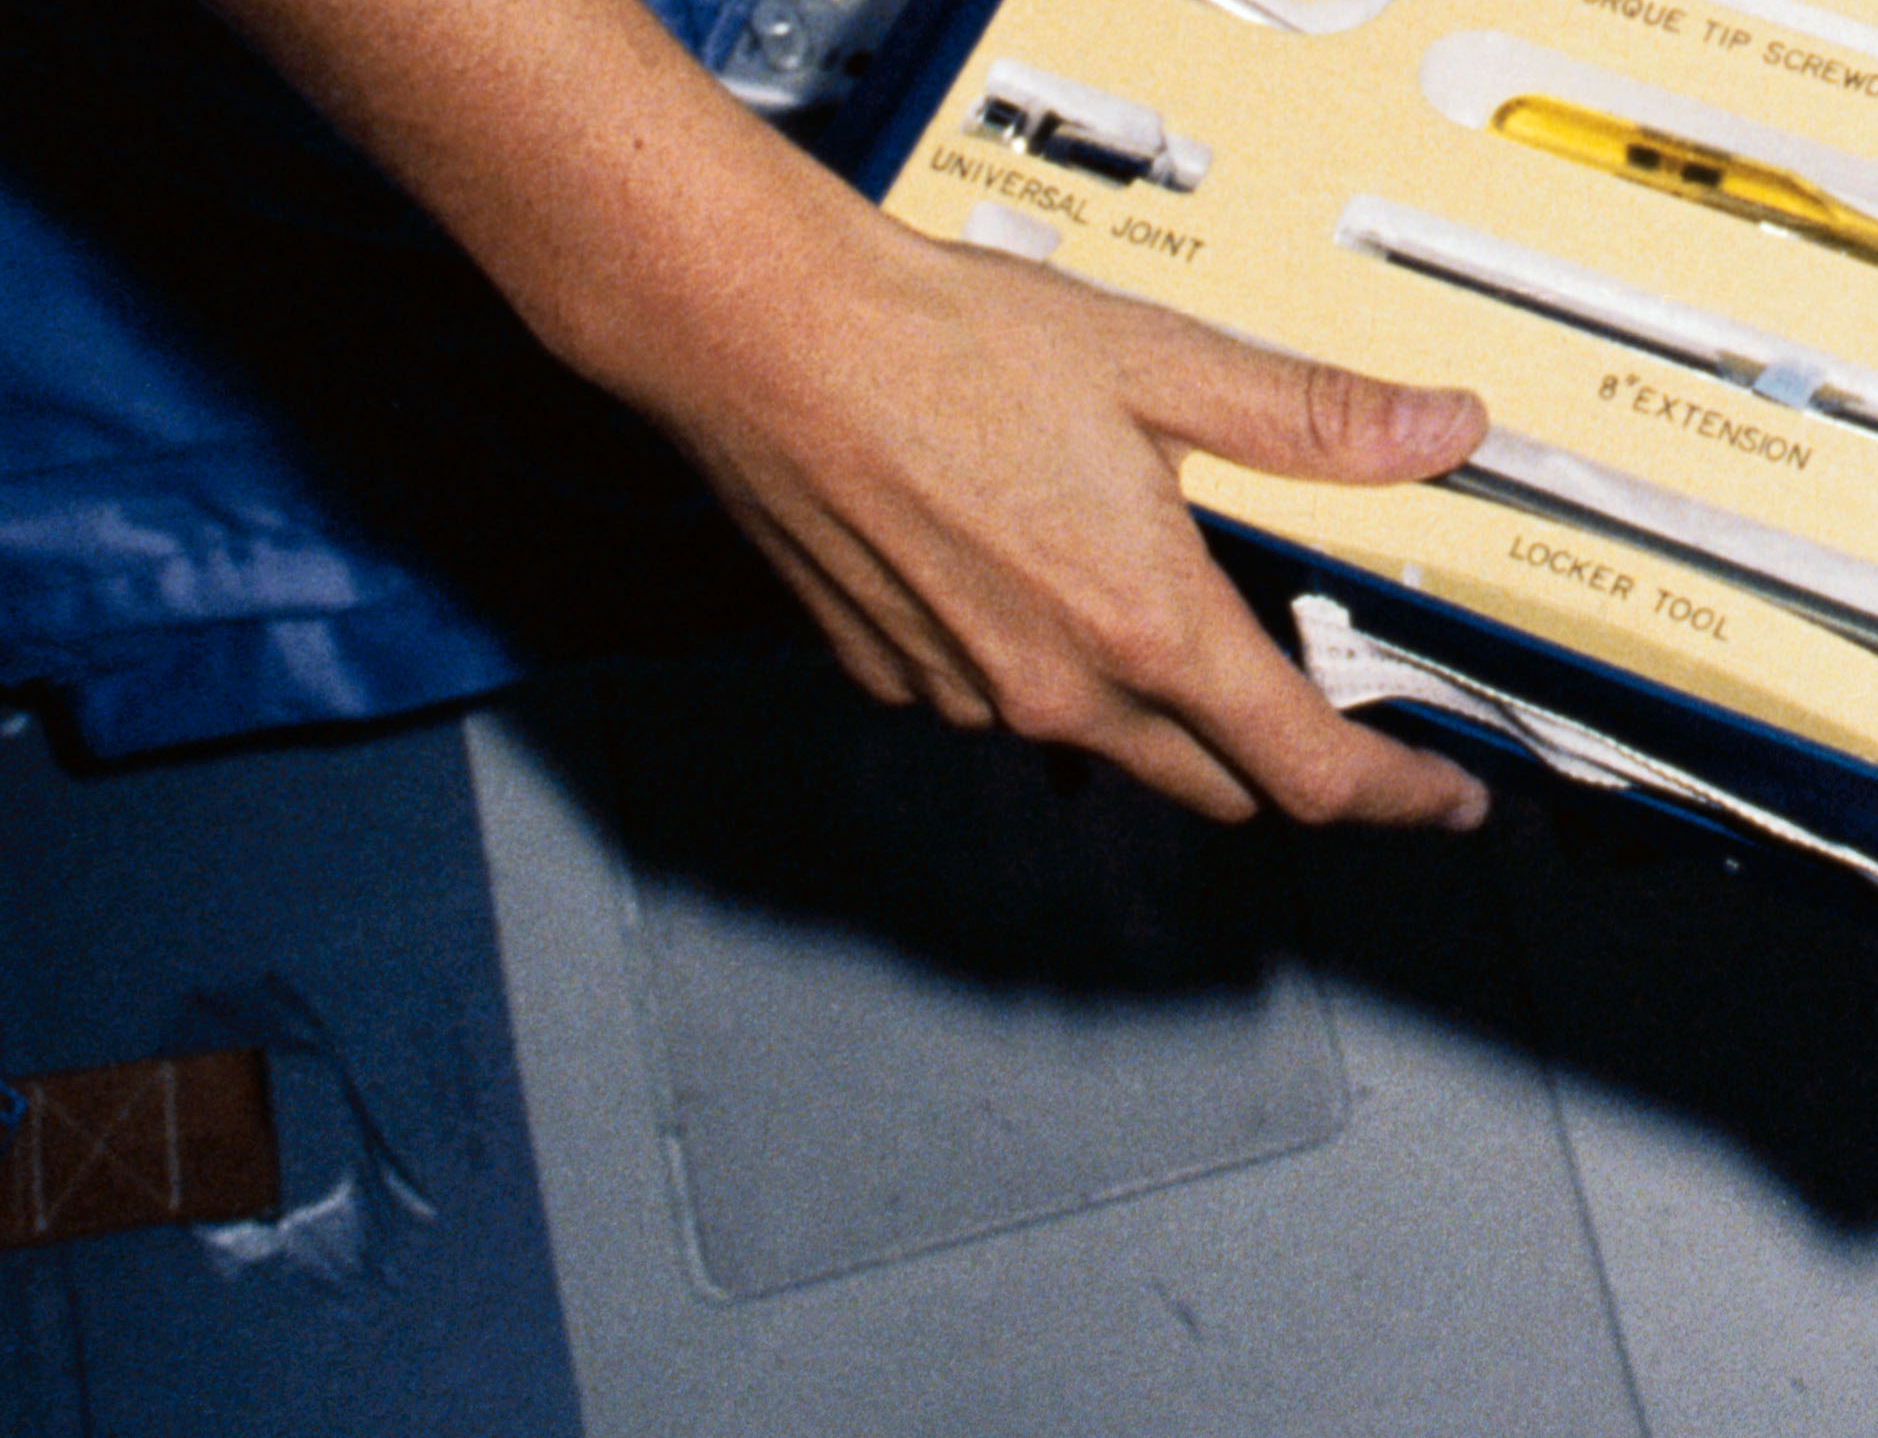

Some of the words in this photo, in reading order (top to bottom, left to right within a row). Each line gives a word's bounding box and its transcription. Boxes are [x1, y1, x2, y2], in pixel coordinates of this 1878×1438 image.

[1700, 18, 1753, 53] TIP
[929, 144, 1095, 229] UNIVERSAL
[1109, 214, 1209, 268] JOINT
[1631, 387, 1815, 472] EXTENSION
[1507, 534, 1636, 602] LOCKER
[1652, 587, 1731, 644] TOOL
